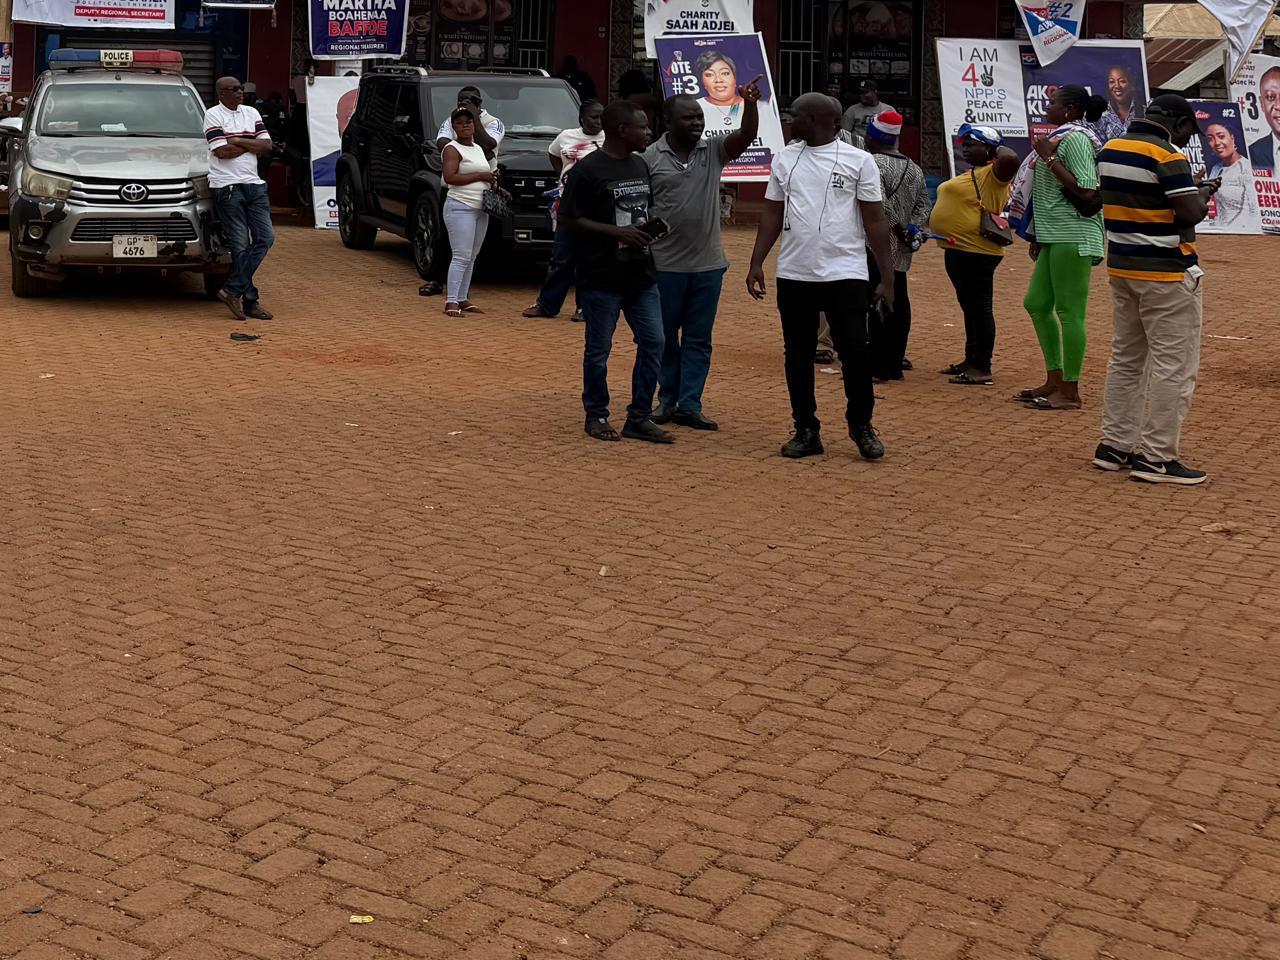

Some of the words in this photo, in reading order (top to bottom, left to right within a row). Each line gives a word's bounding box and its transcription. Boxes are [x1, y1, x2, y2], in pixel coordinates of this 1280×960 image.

[76, 8, 98, 16] DEPUTY
[131, 10, 164, 18] SECRETARY
[680, 10, 720, 20] CHARITY
[328, 21, 388, 37] BAFFOE
[666, 20, 698, 30] SAAH
[702, 21, 734, 32] ADJEI
[104, 52, 130, 60] POLICE
[959, 47, 963, 62] I
[969, 47, 998, 62] AM
[961, 63, 979, 88] 4
[672, 76, 700, 95] #3
[965, 88, 1006, 100] NPP'S
[967, 100, 1003, 110] PEACE
[1222, 109, 1235, 118] #2
[1252, 169, 1270, 177] VOTE
[123, 247, 144, 256] 4676
